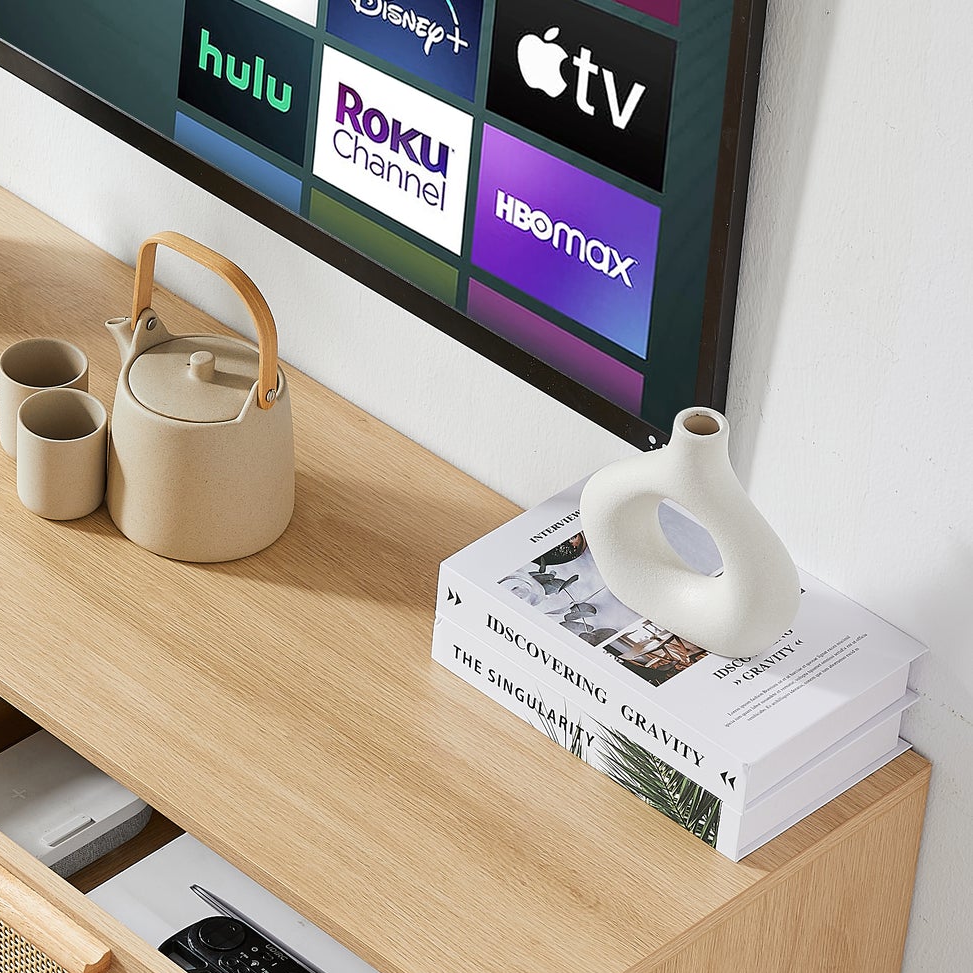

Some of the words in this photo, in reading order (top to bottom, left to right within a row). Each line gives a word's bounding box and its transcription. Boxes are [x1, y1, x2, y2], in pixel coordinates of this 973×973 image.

[198, 27, 293, 113] hulu
[571, 46, 646, 130] tv
[333, 128, 445, 211] Channel
[452, 644, 483, 673] THE
[488, 669, 595, 747] SINGULARITY
[486, 613, 607, 705] IDSCOVERING
[621, 704, 705, 768] GRAVITY
[742, 644, 795, 680] GRAVITY
